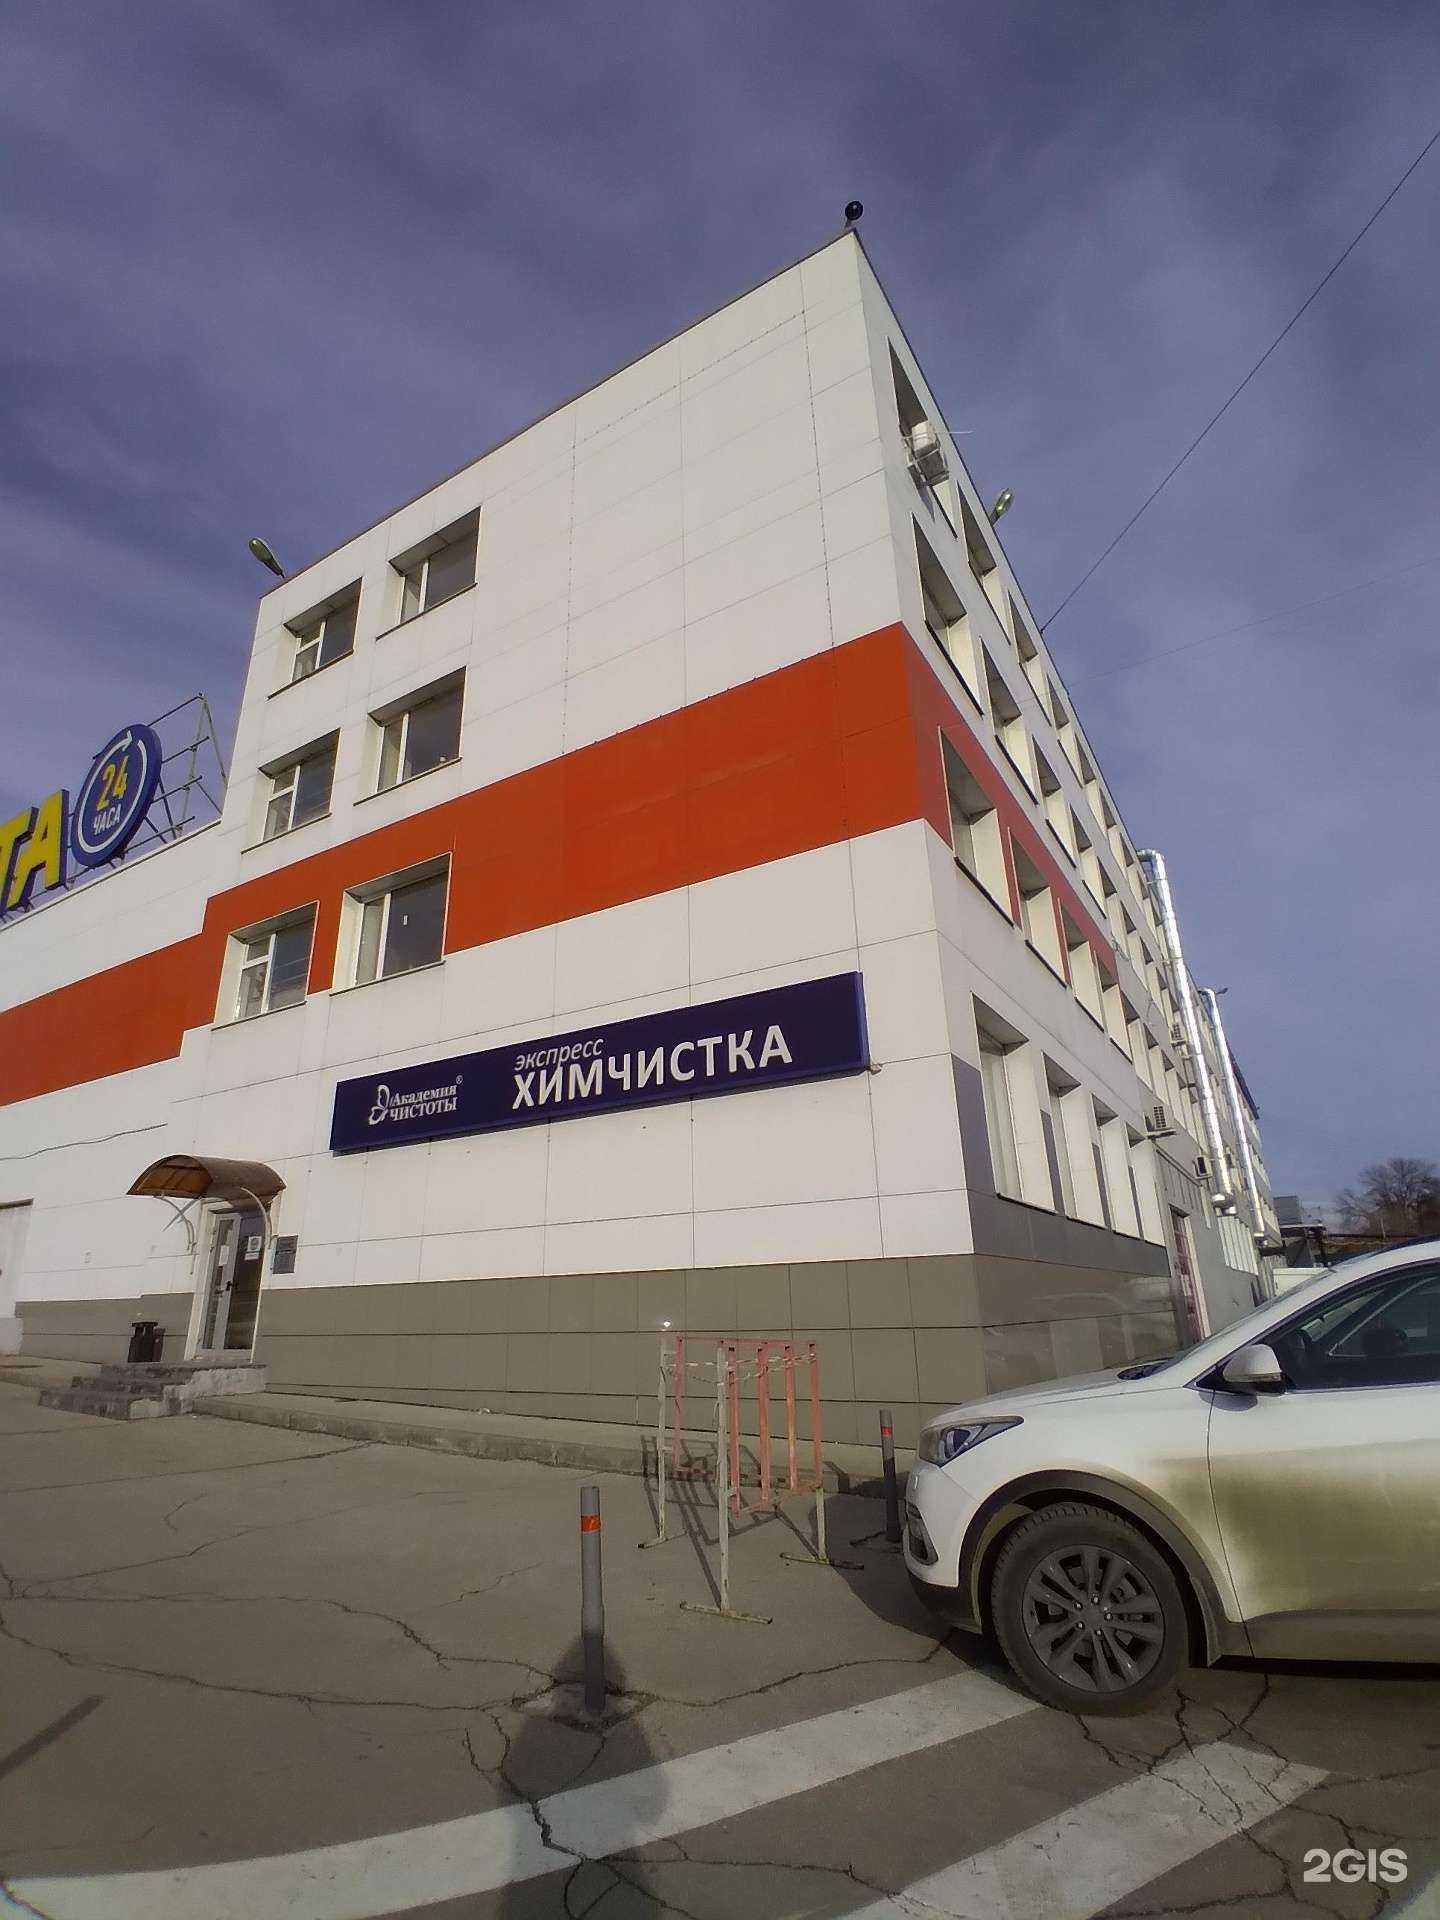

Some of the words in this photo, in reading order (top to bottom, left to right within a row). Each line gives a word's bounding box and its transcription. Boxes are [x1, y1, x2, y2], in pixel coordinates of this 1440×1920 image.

[97, 755, 128, 811] 24
[94, 804, 122, 836] ЧАСА
[512, 1025, 793, 1110] ХИМЧИСТКА
[389, 1097, 458, 1121] ЧИСТОТЫ
